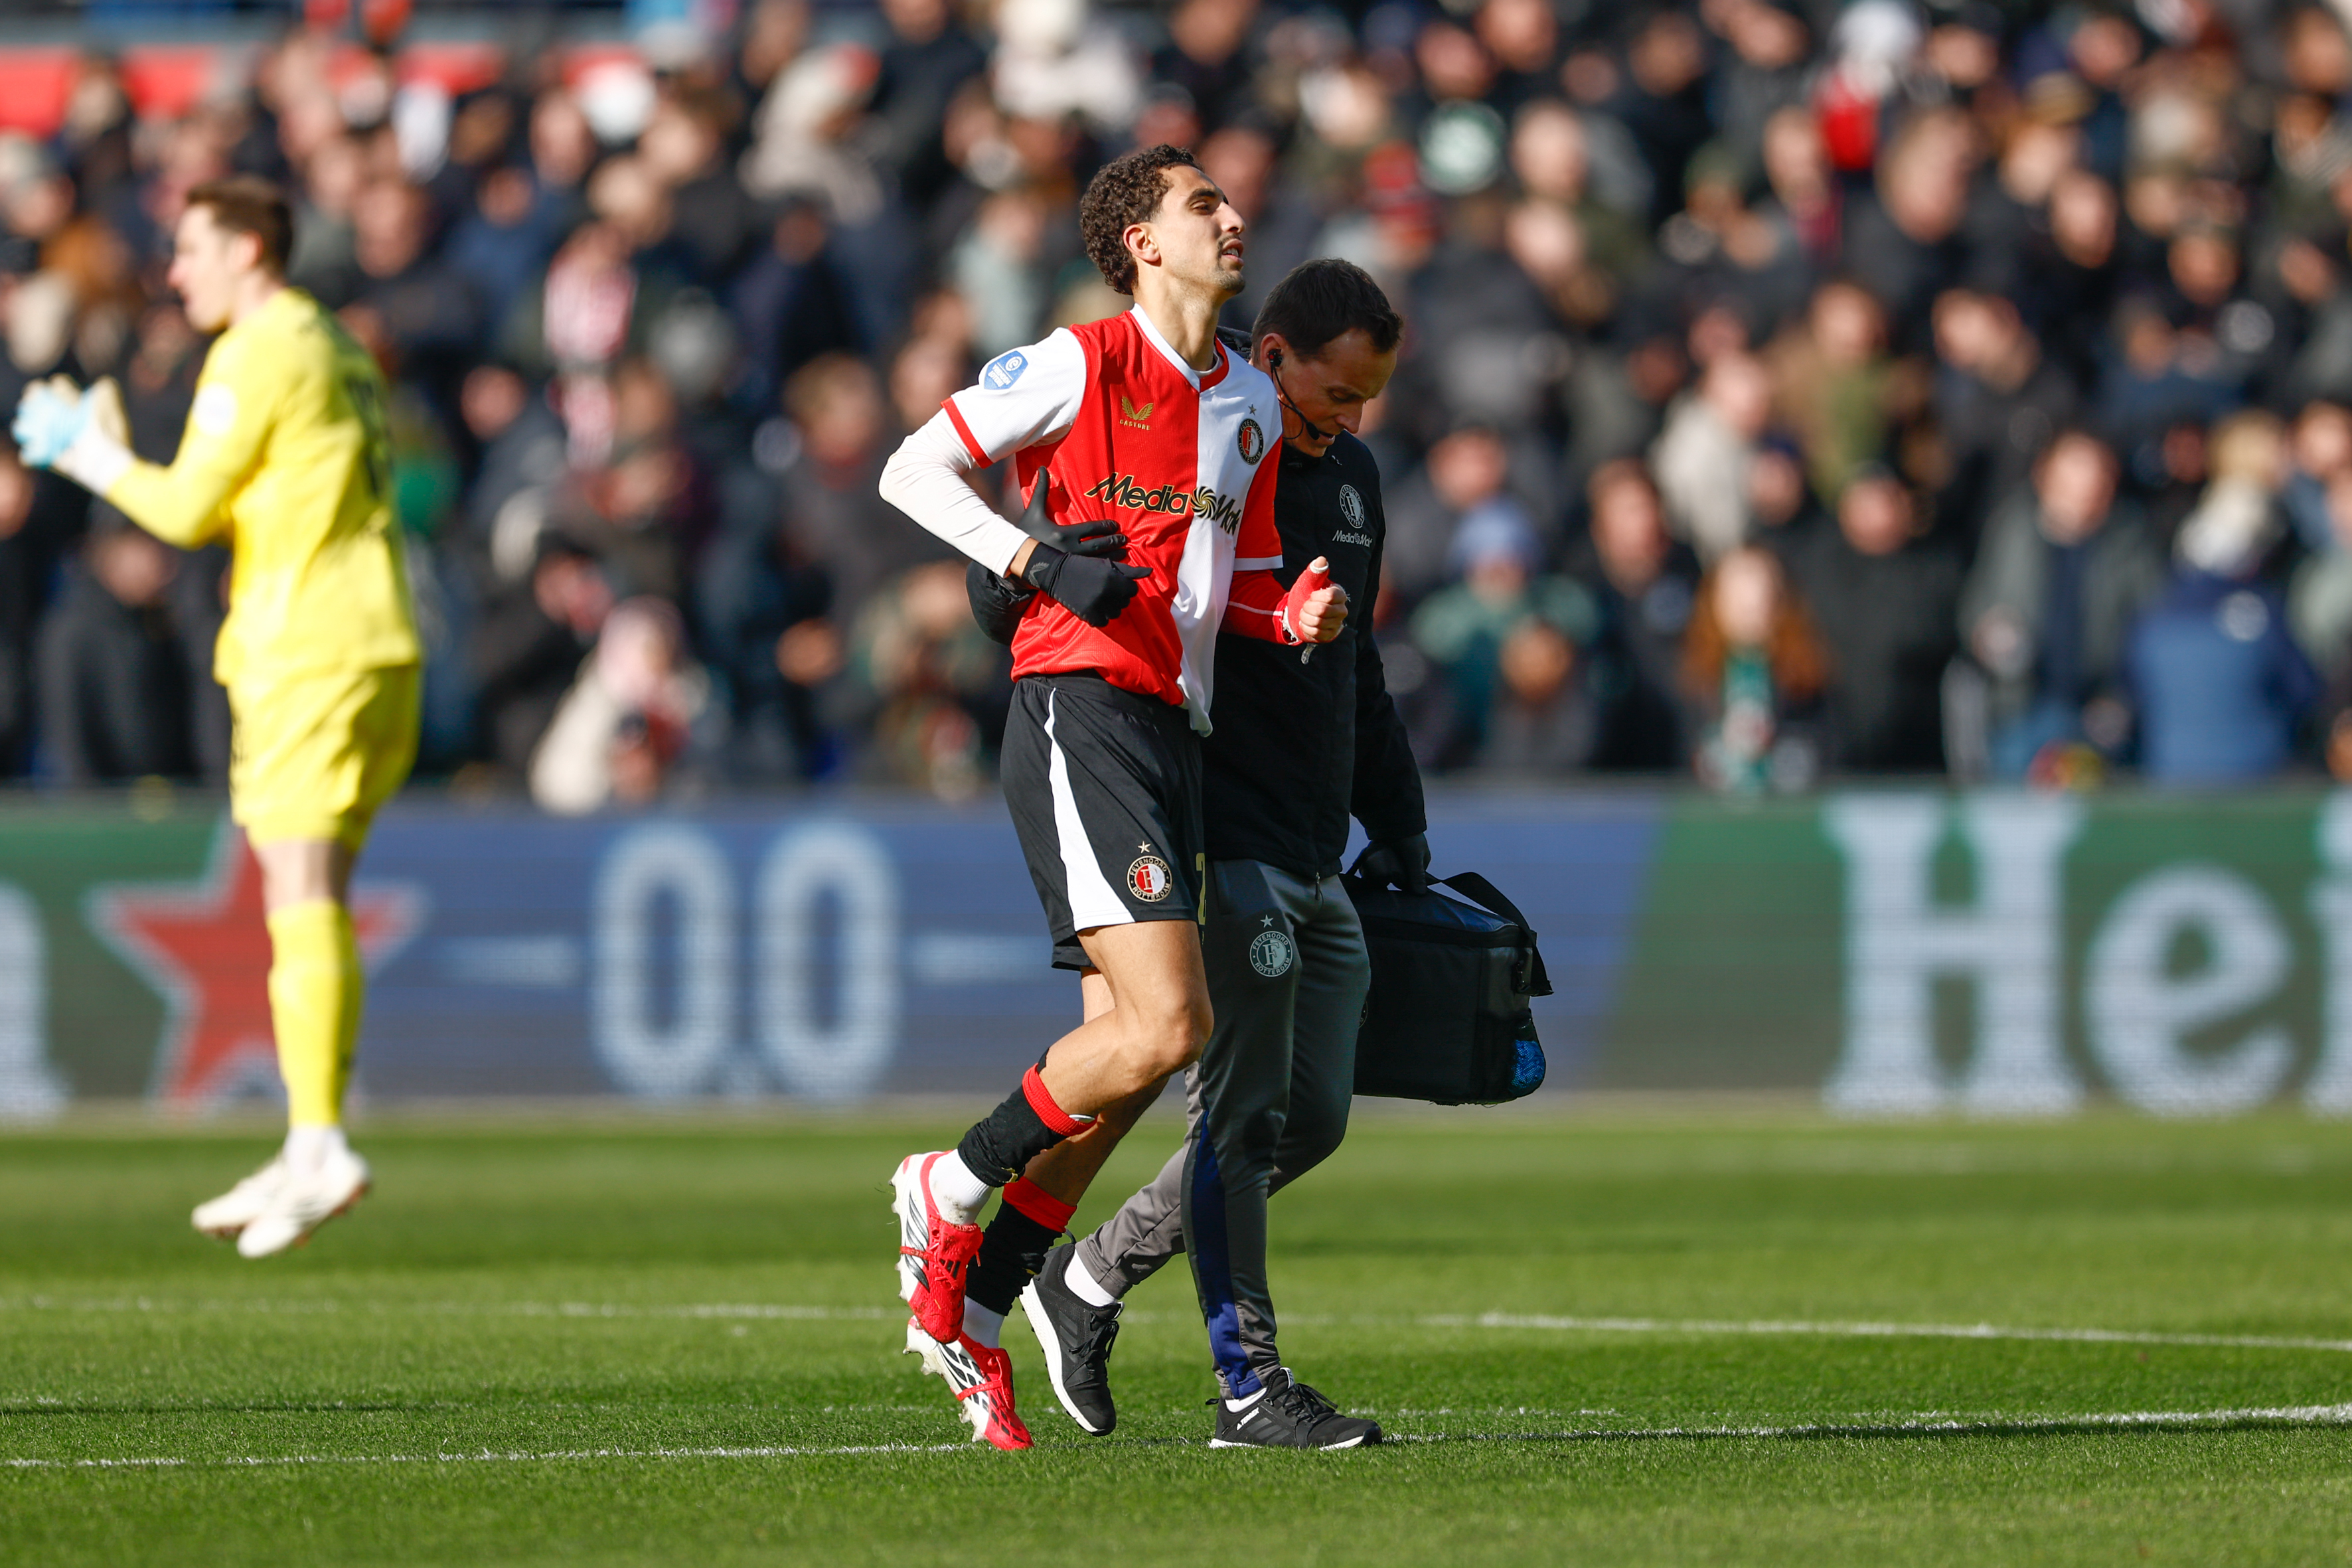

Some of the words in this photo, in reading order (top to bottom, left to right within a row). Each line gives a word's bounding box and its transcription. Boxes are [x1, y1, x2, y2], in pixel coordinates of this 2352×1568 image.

[1119, 419, 1150, 431] CASTORE
[1240, 420, 1263, 440] FEYENOORD
[1238, 443, 1262, 463] ROTTERDAM
[1083, 472, 1190, 515] Media
[1332, 530, 1354, 544] Media
[1130, 858, 1167, 876] FEYENOORD
[1132, 883, 1171, 901] ROTTERDAM
[1253, 933, 1289, 950] FEYENOORD
[1255, 957, 1291, 975] ROTTERDAM
[1240, 1407, 1260, 1426] TERREX
